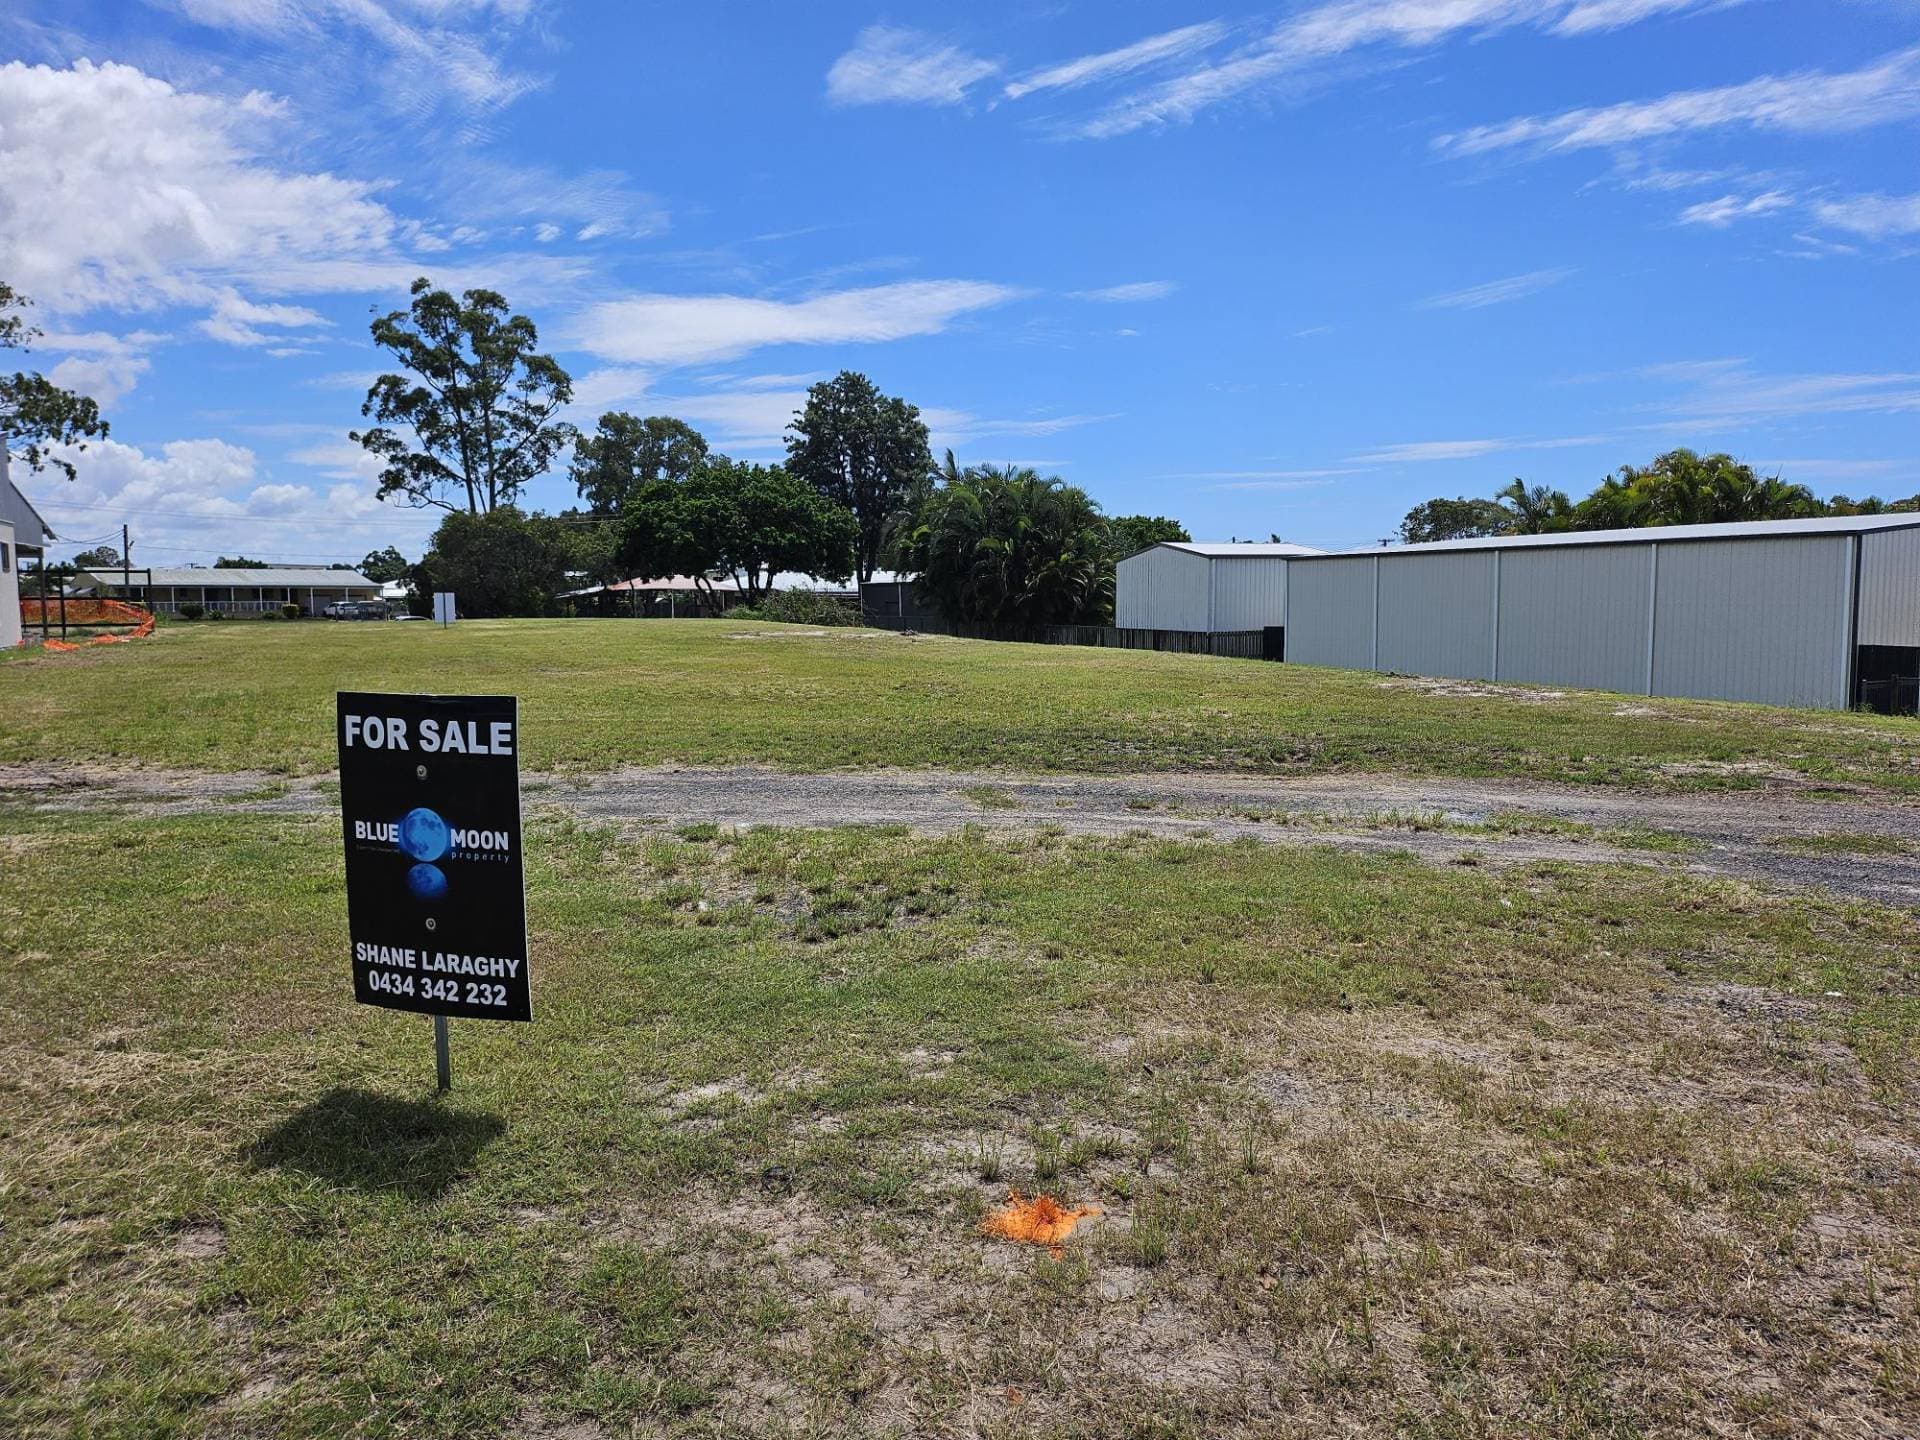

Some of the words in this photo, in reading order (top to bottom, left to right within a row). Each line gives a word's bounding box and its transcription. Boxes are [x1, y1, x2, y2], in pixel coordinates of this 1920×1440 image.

[345, 715, 410, 751] FOR
[419, 719, 513, 756] SALE
[355, 820, 399, 843] BLUE
[450, 829, 509, 851] MOON
[451, 851, 511, 864] property
[356, 942, 416, 970] SHANE
[421, 951, 520, 978] LARAGHY
[368, 970, 415, 997] 0434
[420, 977, 459, 1002] 342
[465, 982, 508, 1006] 232
